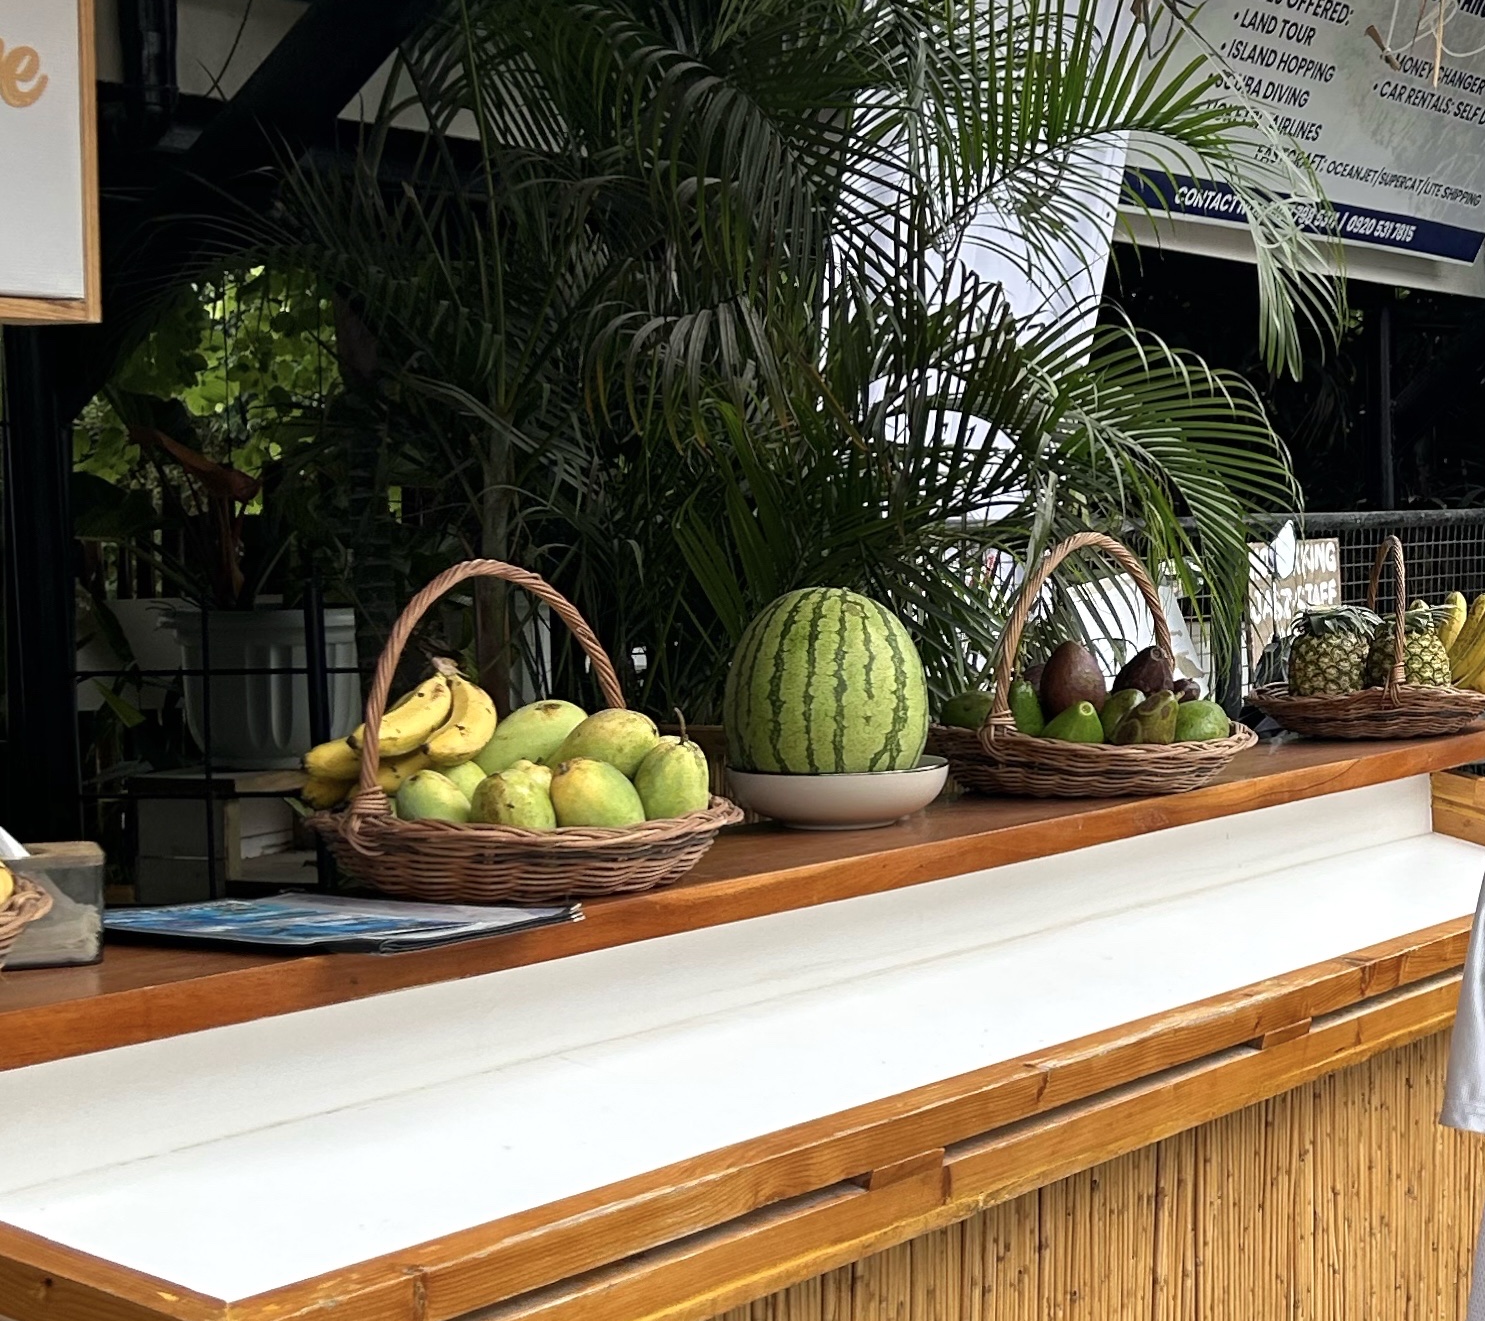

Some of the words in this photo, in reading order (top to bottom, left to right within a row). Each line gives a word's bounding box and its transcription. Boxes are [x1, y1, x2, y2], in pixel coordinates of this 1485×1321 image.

[1240, 8, 1278, 35] LAND
[1278, 18, 1316, 47] TOUR
[1227, 39, 1278, 68] ISLAND
[1276, 52, 1336, 83] HOPPING
[1262, 81, 1311, 108] DIVING
[1380, 81, 1407, 102] CAR
[1453, 101, 1482, 122] SELF
[1269, 114, 1323, 142] AIRLINES
[1174, 186, 1241, 214] CONTACT
[1346, 215, 1377, 236] 0920
[1441, 186, 1482, 207] SHIPPING
